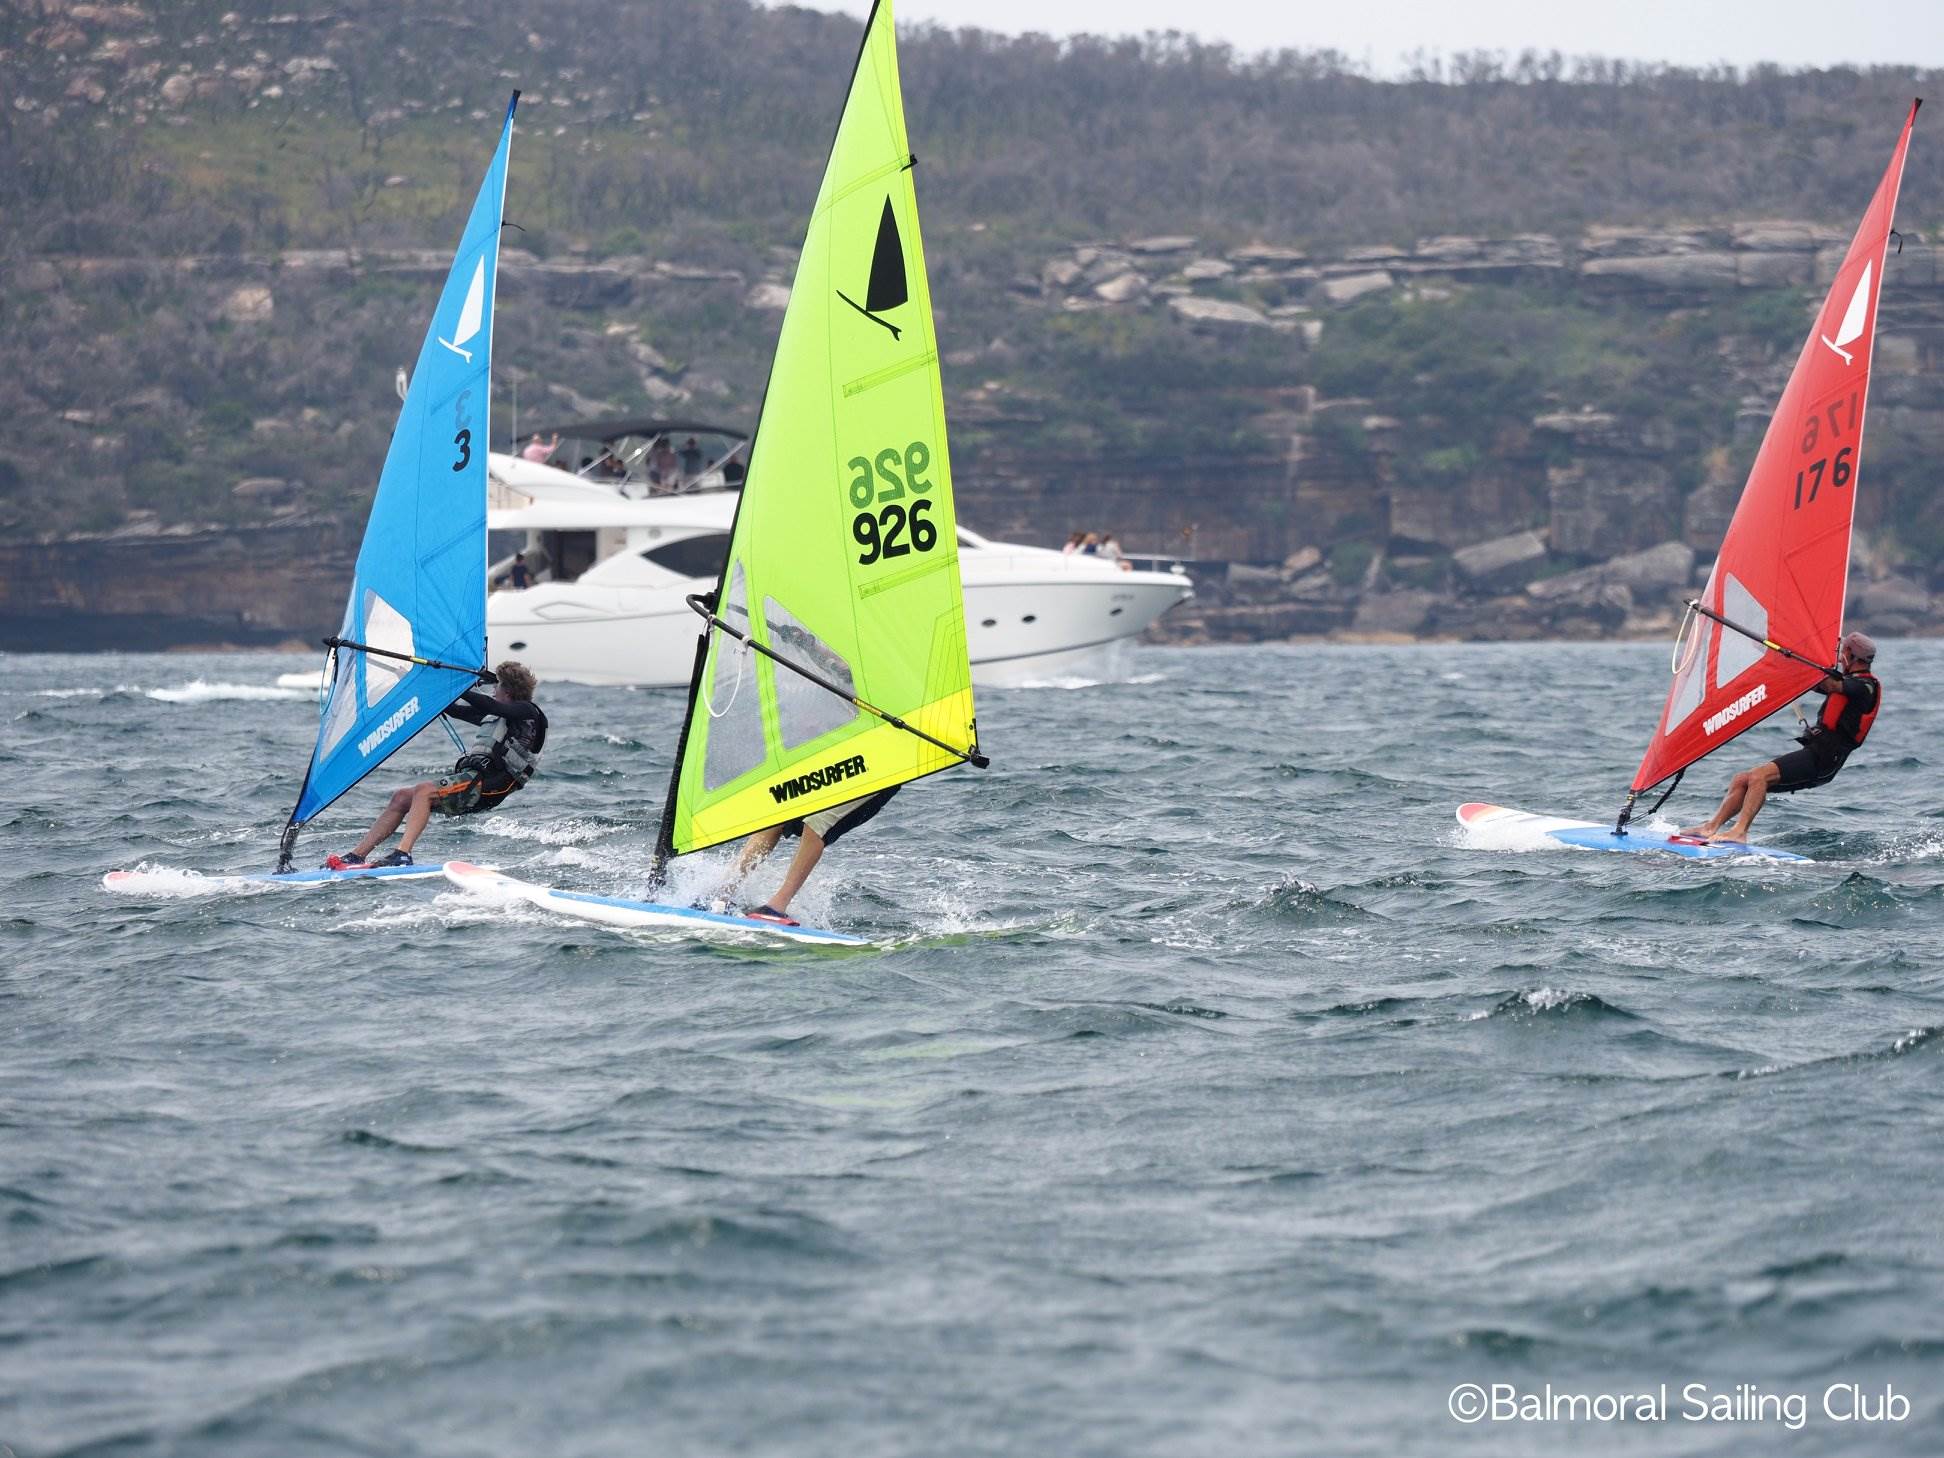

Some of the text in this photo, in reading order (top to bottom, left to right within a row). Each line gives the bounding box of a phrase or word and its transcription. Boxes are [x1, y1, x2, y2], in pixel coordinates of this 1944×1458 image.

[452, 428, 471, 473] 3
[1793, 446, 1852, 511] 176
[852, 499, 938, 566] 926
[357, 695, 420, 758] WINDSURFER
[1702, 683, 1767, 737] WINDSURFER
[769, 754, 867, 804] WINDSURFER
